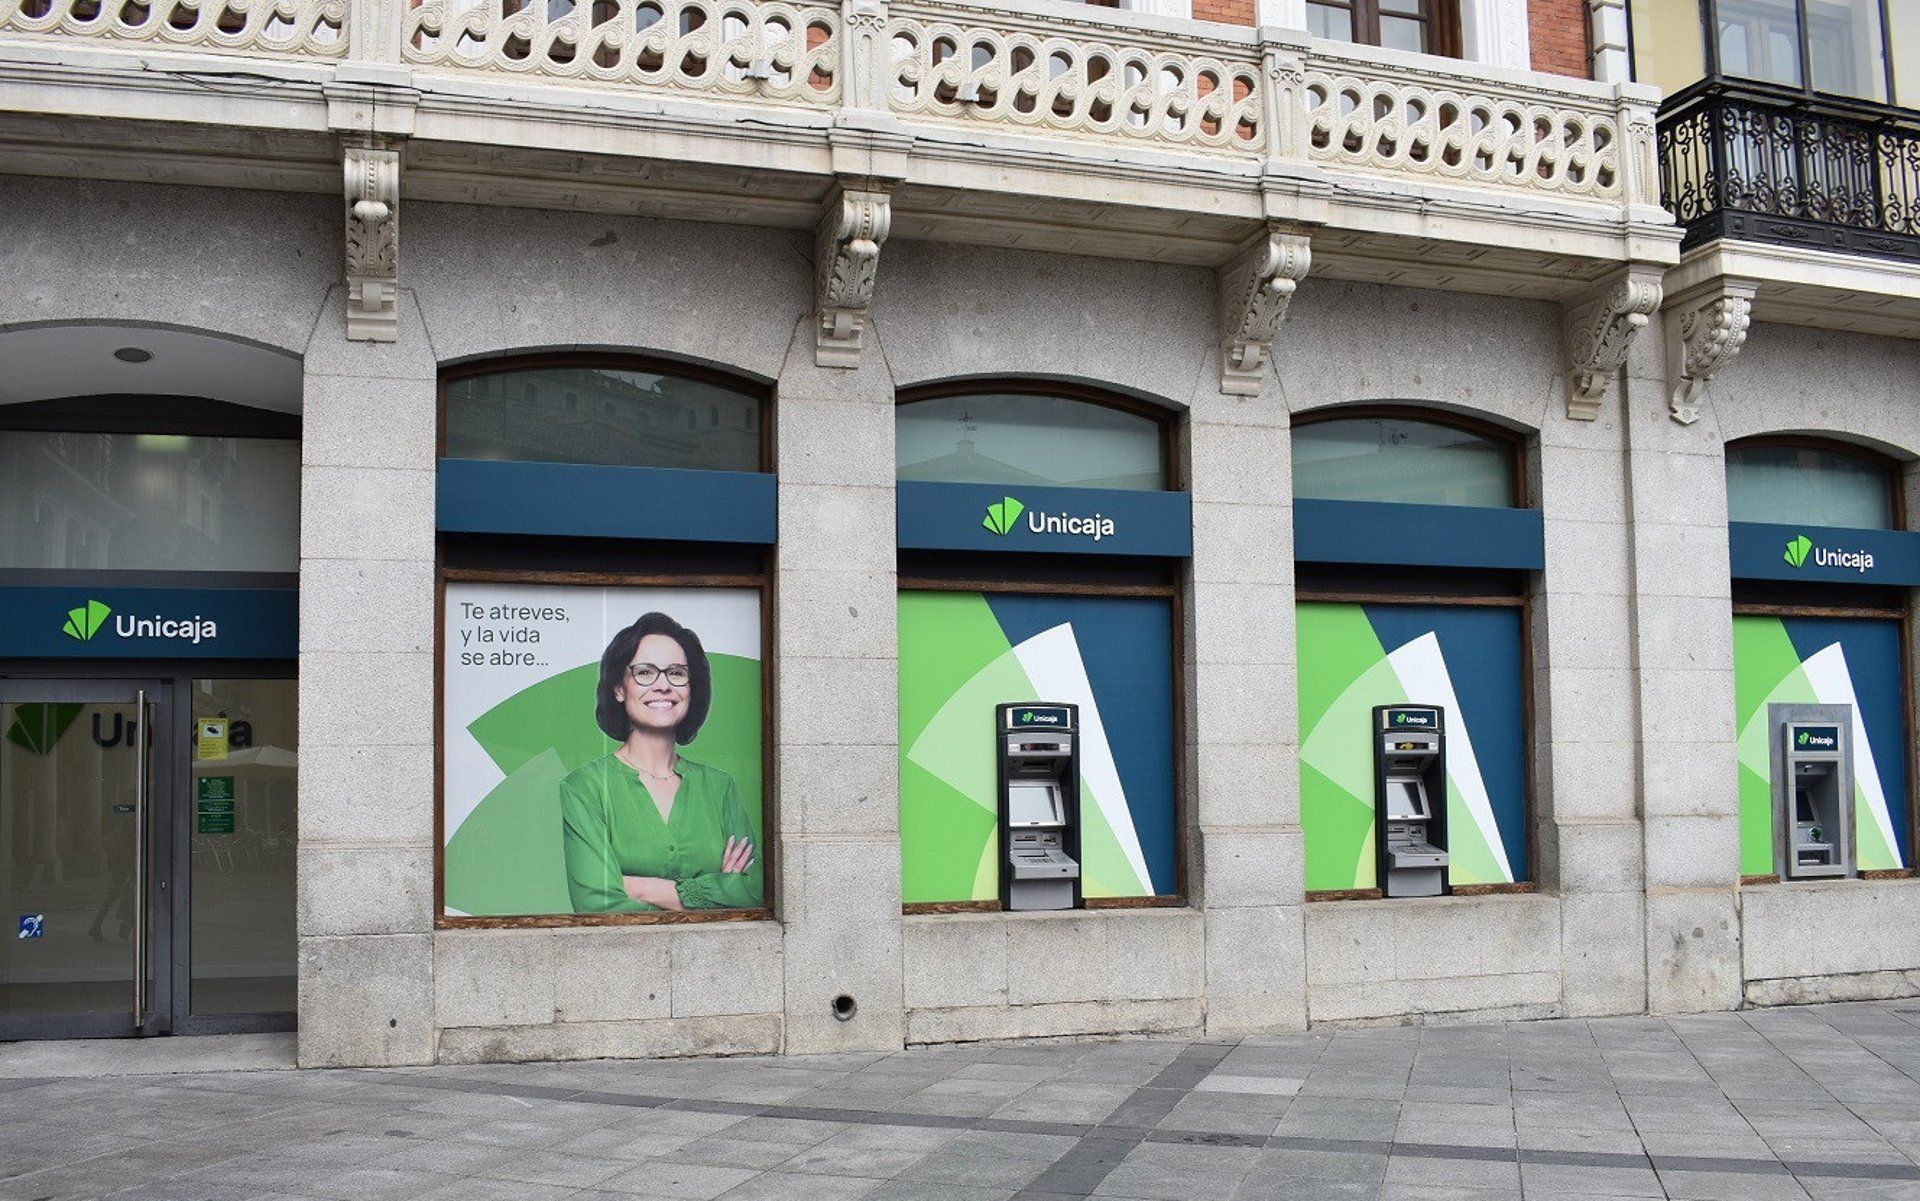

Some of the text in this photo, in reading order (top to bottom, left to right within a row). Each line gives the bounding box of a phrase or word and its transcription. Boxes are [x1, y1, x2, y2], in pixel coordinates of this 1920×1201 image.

[1028, 511, 1115, 541] Unicaja
[1815, 547, 1874, 573] Unicaja
[461, 602, 570, 624] Te atreves,
[116, 615, 217, 644] Unicaja
[461, 625, 540, 647] y la vida
[461, 649, 549, 666] se abre...
[1809, 736, 1834, 747] Unicaja
